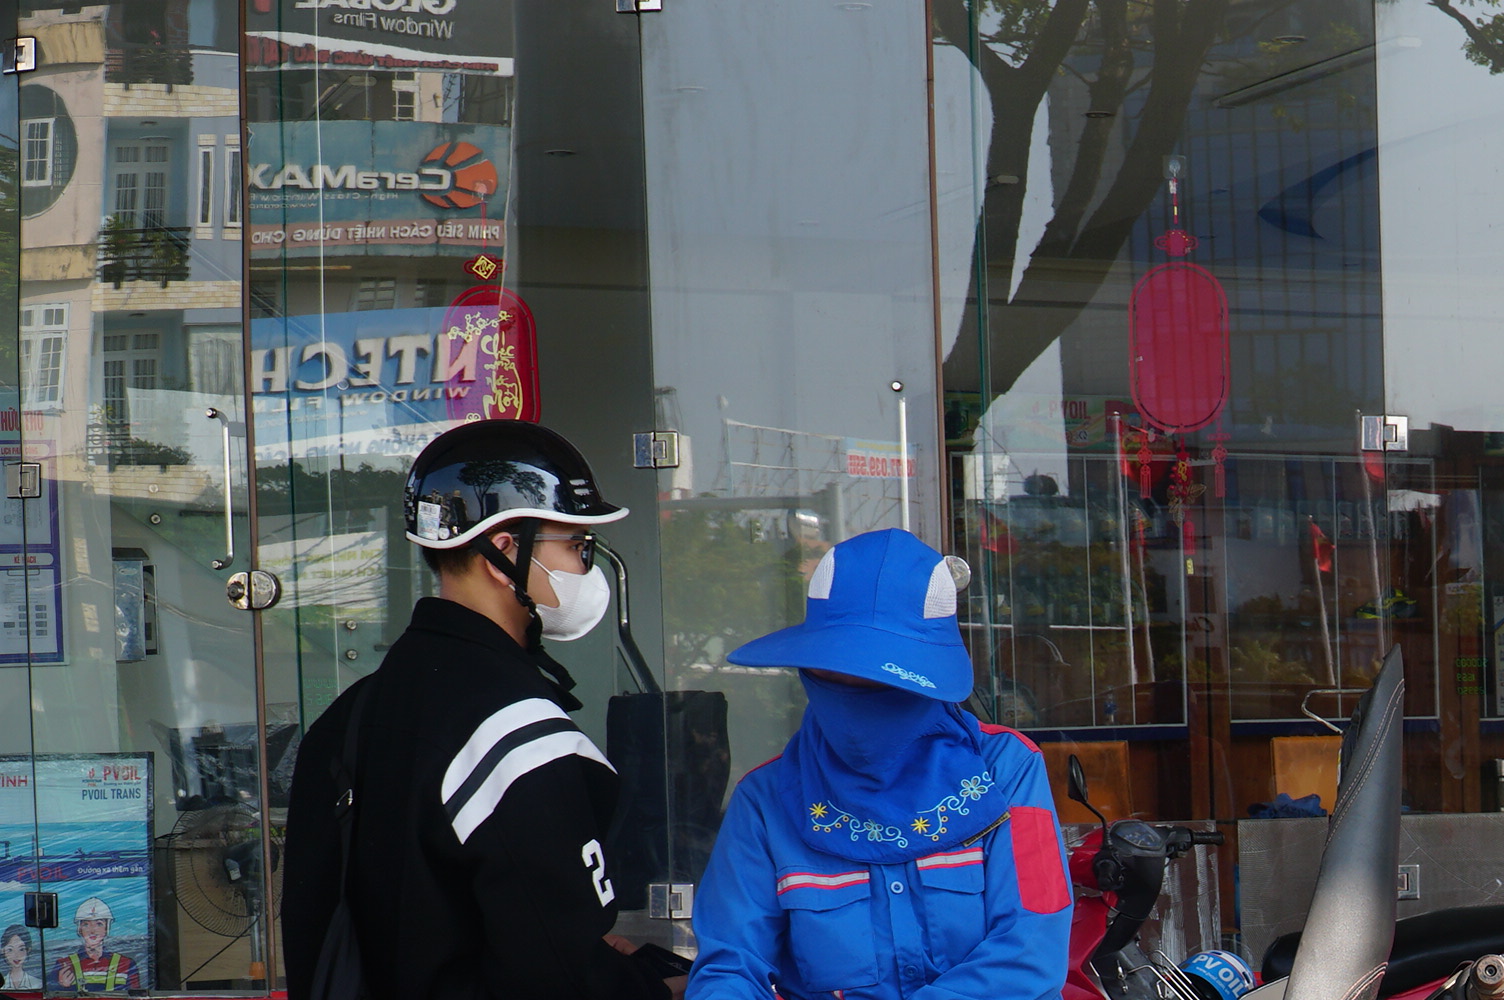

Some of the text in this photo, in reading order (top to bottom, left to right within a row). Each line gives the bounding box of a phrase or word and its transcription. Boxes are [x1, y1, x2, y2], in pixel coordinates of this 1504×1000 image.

[103, 766, 141, 780] PVOIL
[82, 788, 141, 800] PVOIL TRANS
[581, 838, 616, 908] 2
[1192, 954, 1244, 999] PV OIL
